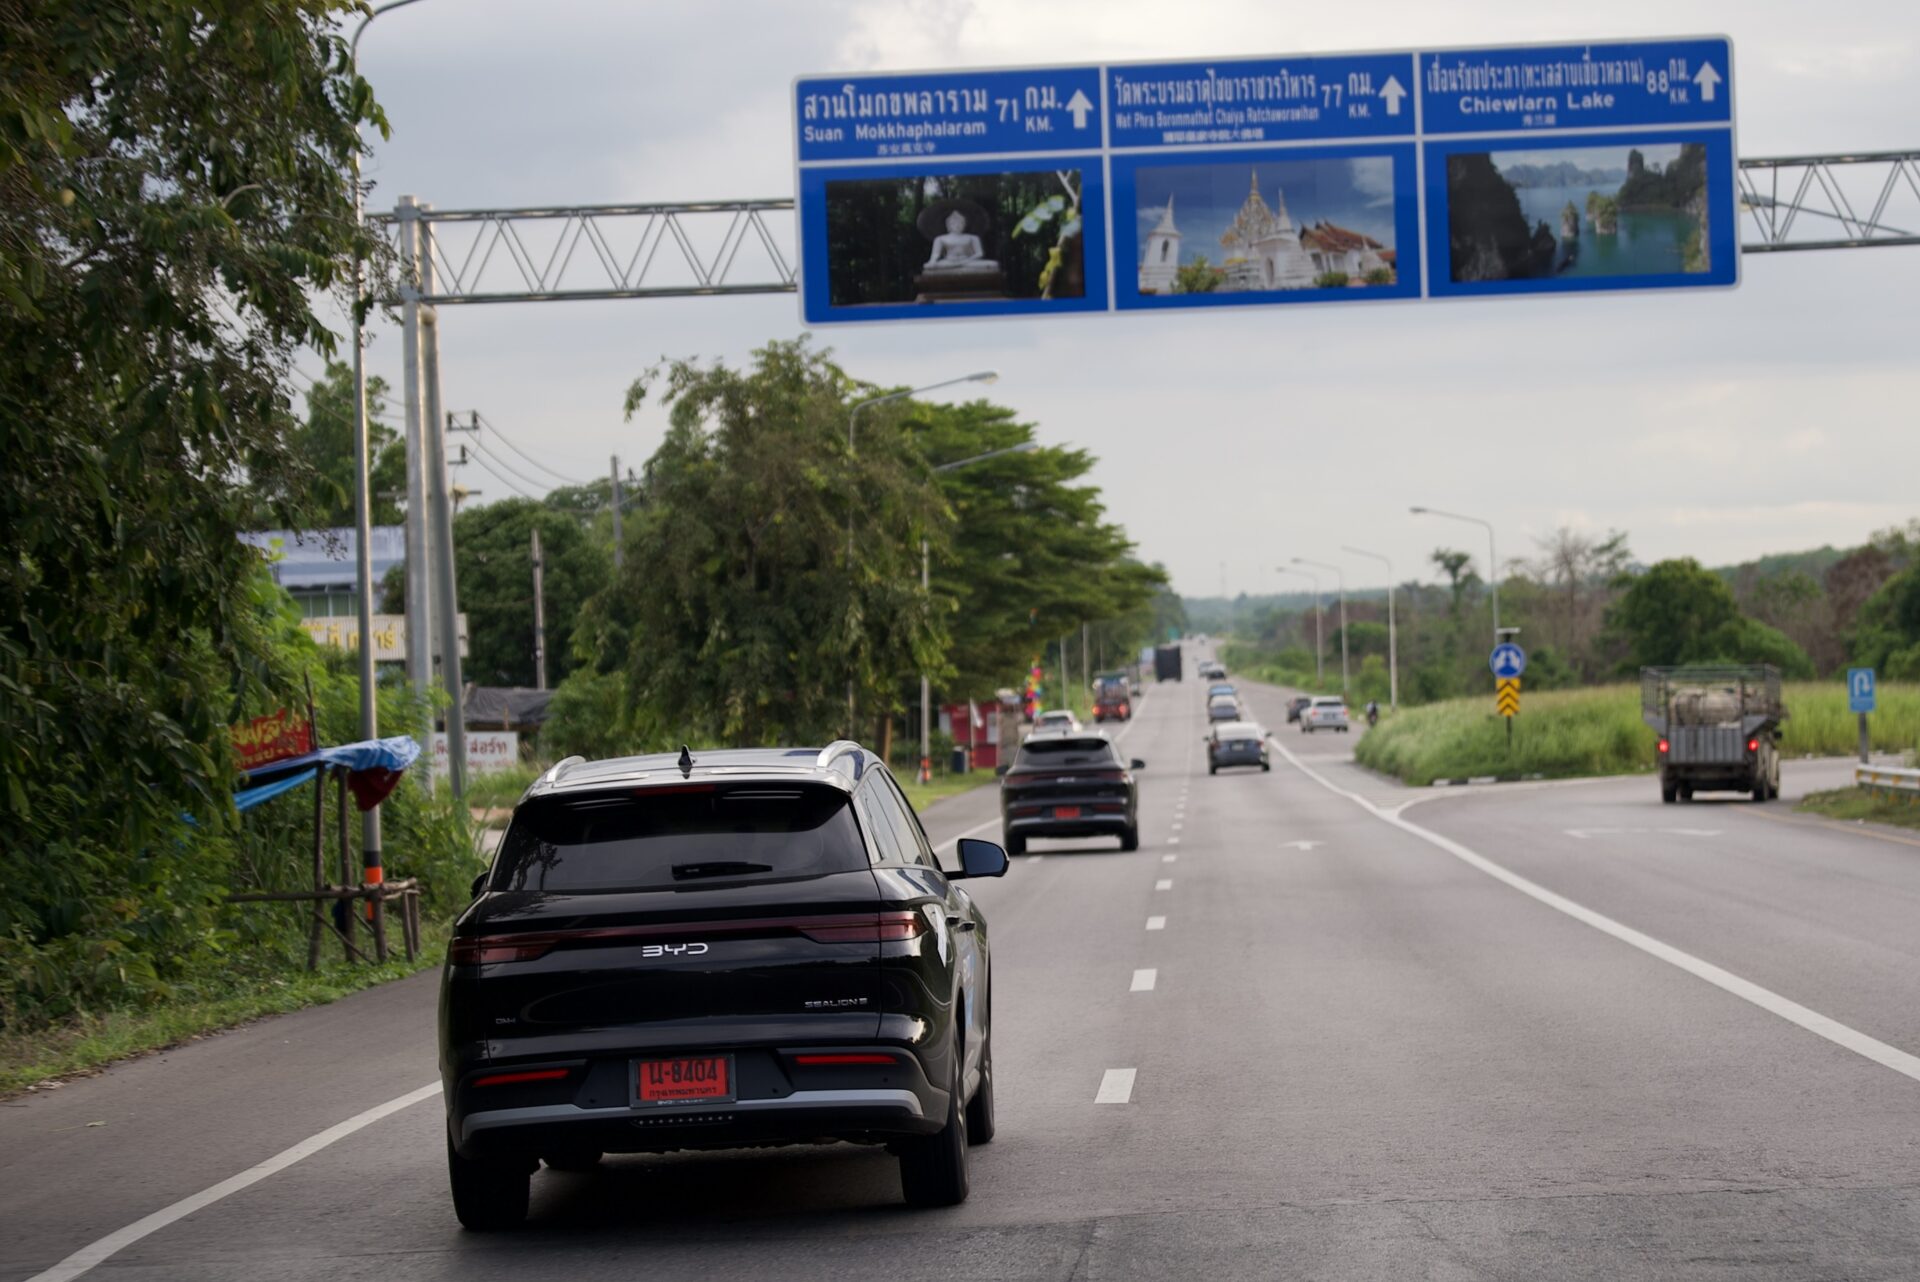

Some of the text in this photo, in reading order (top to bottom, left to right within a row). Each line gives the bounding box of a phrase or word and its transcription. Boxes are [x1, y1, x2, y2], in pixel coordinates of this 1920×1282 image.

[1646, 70, 1669, 94] 88
[995, 98, 1019, 123] 71
[1025, 85, 1062, 110] กม.
[1321, 84, 1343, 108] 77
[1459, 91, 1615, 114] Chiewlarn Lake
[1025, 115, 1054, 133] KM.
[1115, 112, 1131, 128] Wat
[1134, 111, 1154, 128] Phra
[1215, 107, 1245, 126] Chaiya
[804, 121, 986, 142] Suan Mokkhaphalaram
[642, 942, 709, 958] BYD
[804, 998, 858, 1009] SEALION
